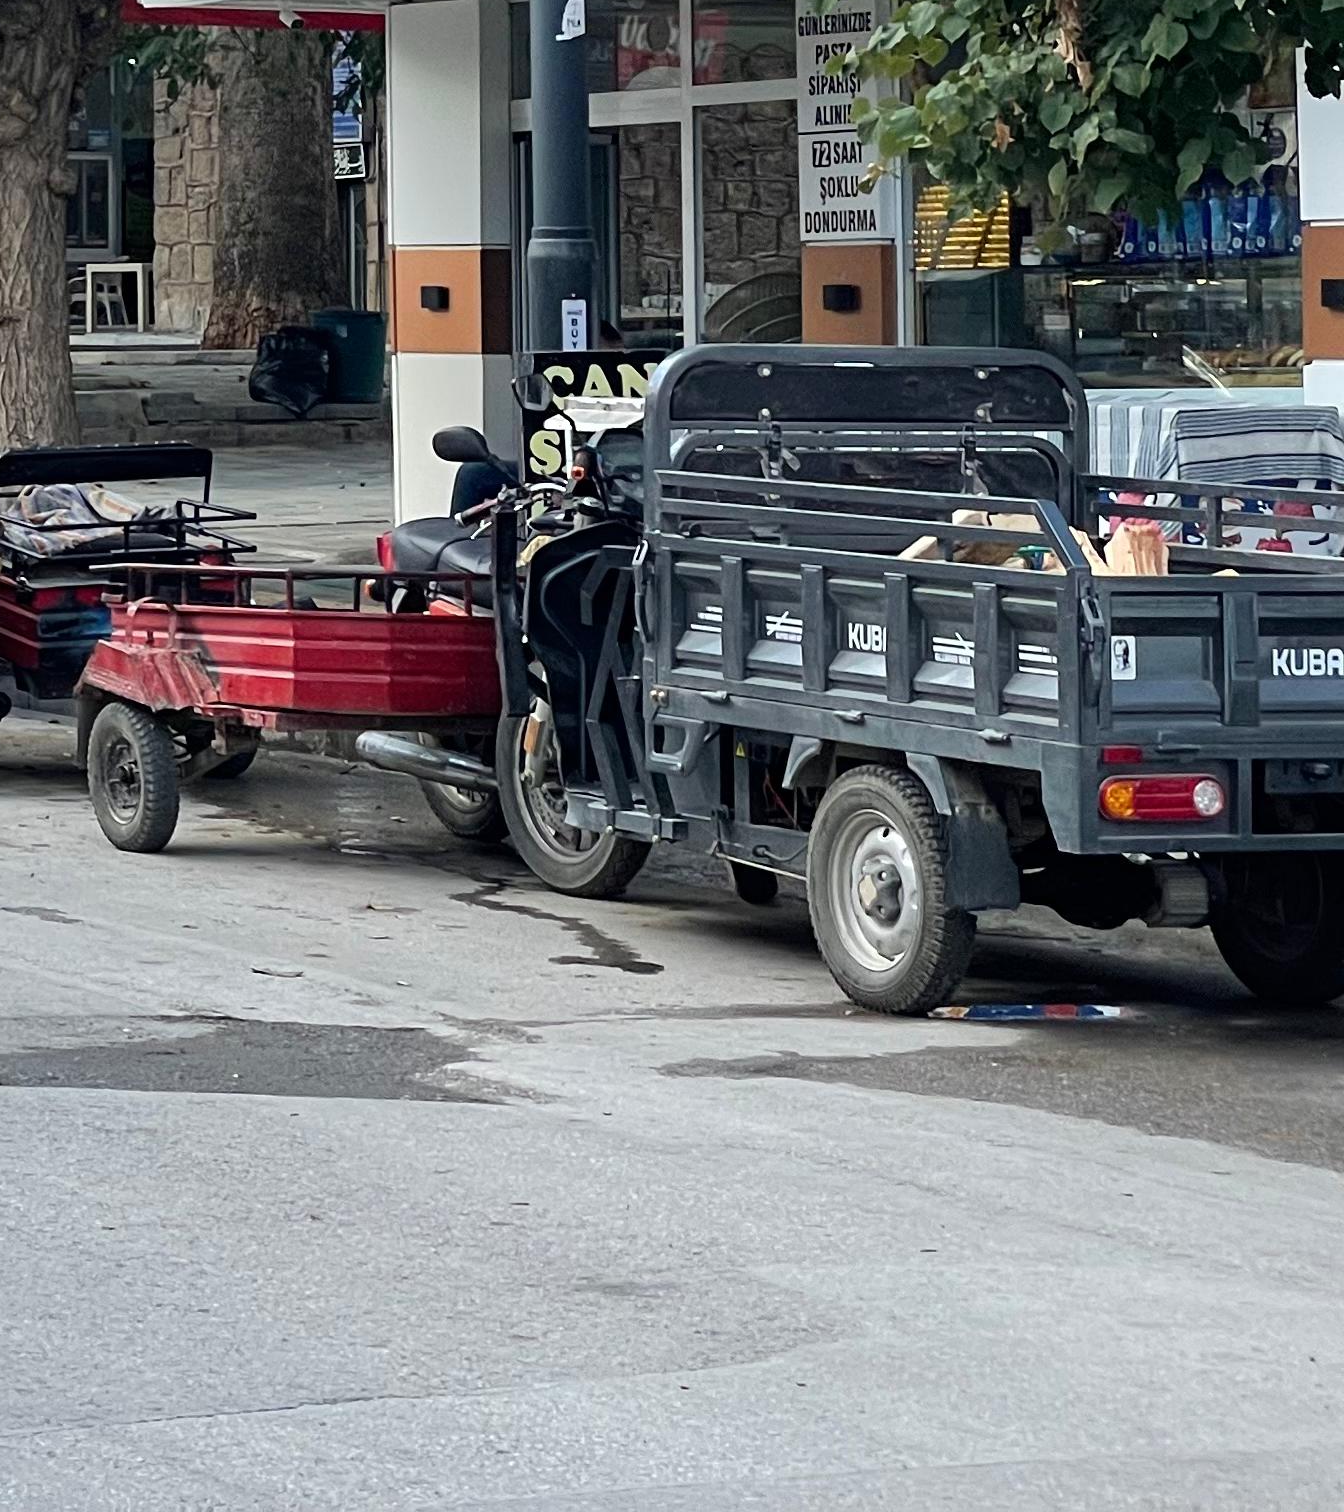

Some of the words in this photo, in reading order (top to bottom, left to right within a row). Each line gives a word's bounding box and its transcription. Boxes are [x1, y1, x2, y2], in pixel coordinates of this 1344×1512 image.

[798, 9, 872, 37] GÜNLERİNİZDE
[813, 141, 831, 167] 72
[833, 141, 864, 165] SAAT
[820, 176, 859, 205] ŞOKLU
[805, 209, 877, 234] DONDURMA
[848, 622, 887, 652] KUB
[1272, 647, 1344, 677] KUBA
